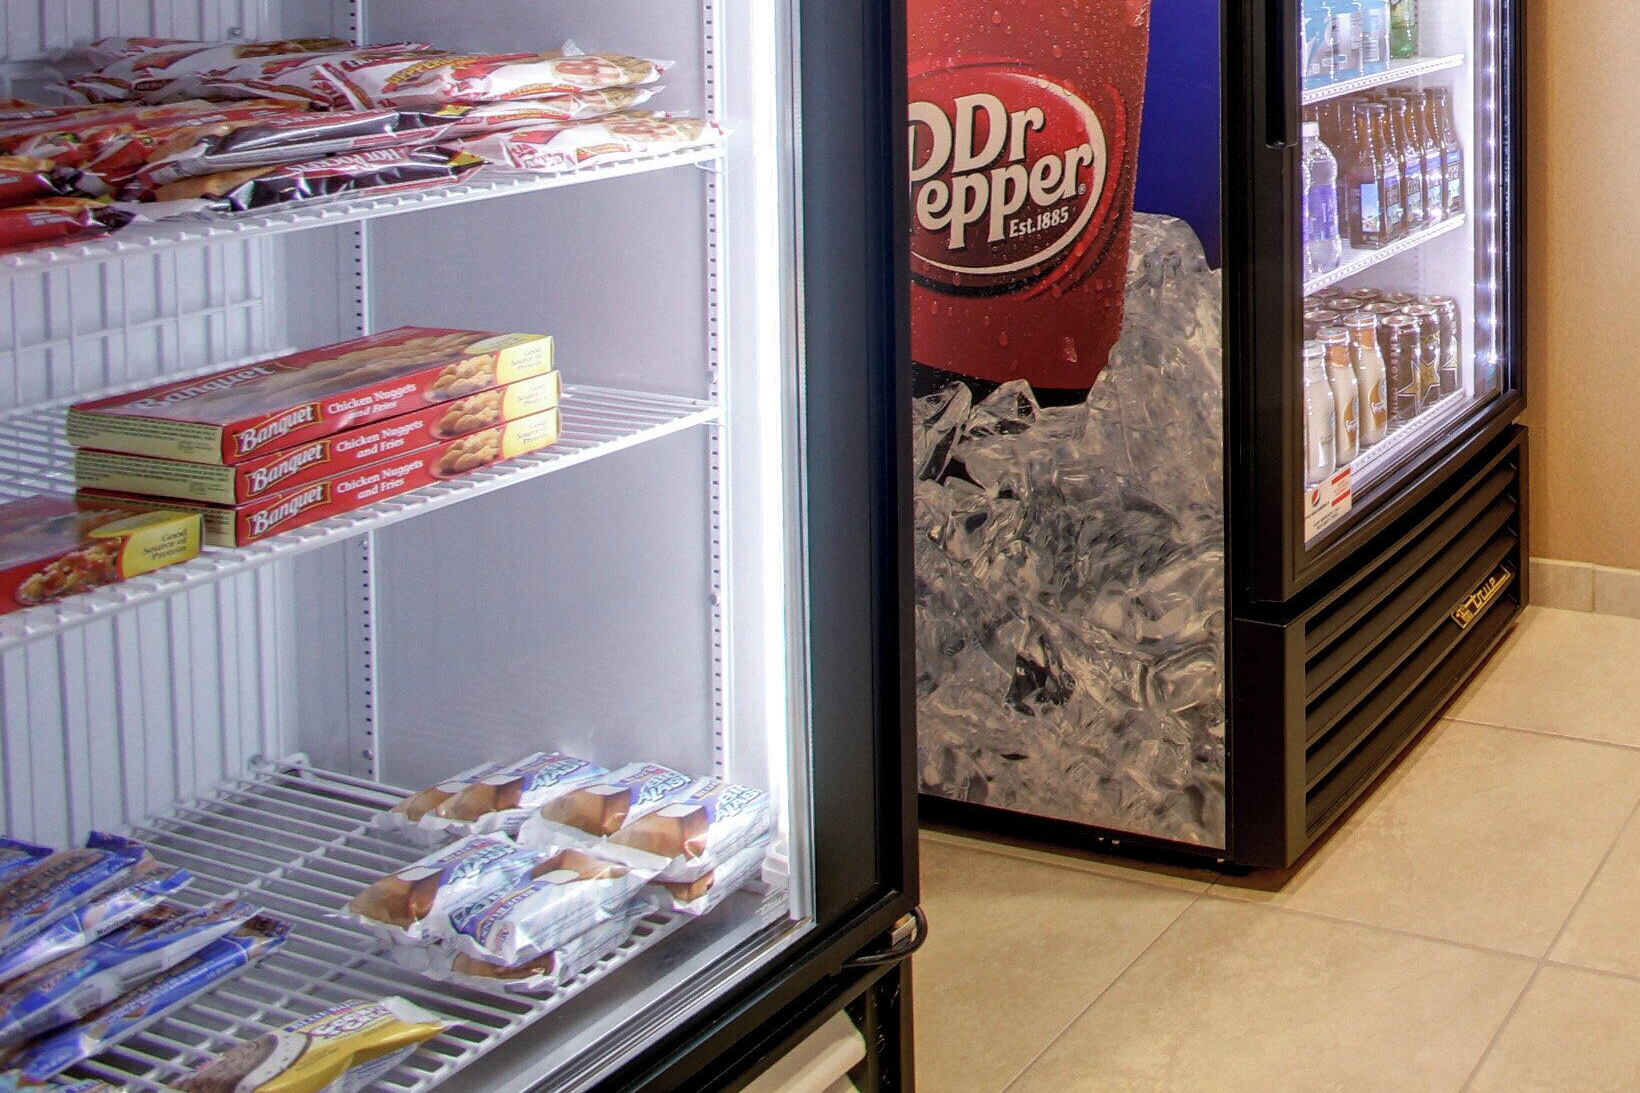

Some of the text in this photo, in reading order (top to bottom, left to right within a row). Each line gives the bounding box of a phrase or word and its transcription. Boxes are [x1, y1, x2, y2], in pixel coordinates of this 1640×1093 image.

[951, 93, 1046, 174] Dr
[127, 365, 277, 410] Banquet
[328, 383, 418, 415] Chicken Nuggets
[349, 400, 398, 420] and Fries
[240, 405, 314, 453] Banquet
[335, 419, 424, 452] Chicken Nuggets
[357, 438, 406, 458] and Fries
[252, 443, 324, 493] Banquet
[336, 459, 424, 494] Chicken Nuggets
[357, 478, 406, 500] and Fries
[252, 485, 324, 536] Banquet
[143, 541, 175, 555] Source
[161, 528, 188, 542] Good
[152, 545, 188, 561] Protein
